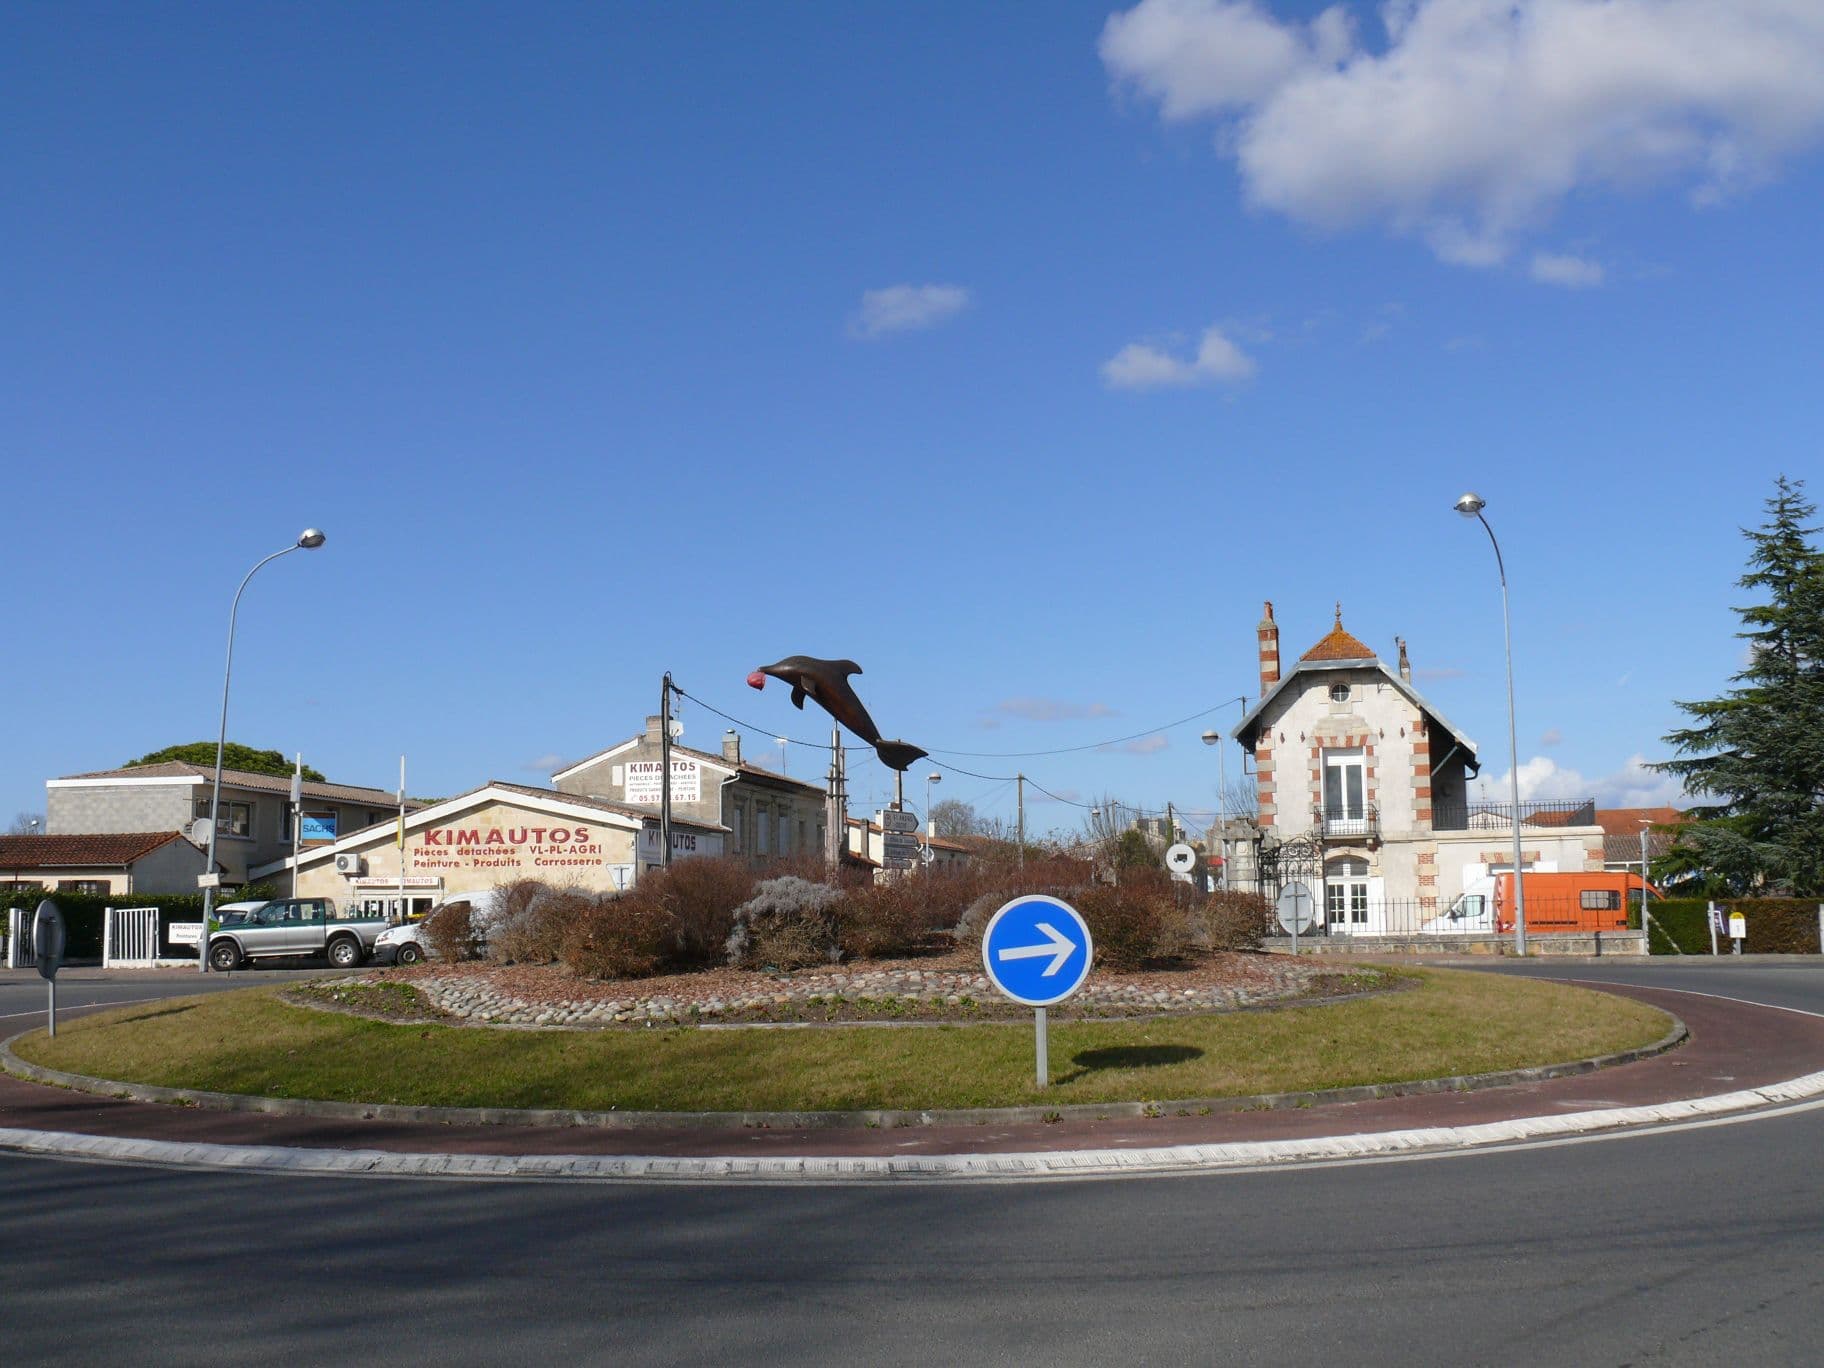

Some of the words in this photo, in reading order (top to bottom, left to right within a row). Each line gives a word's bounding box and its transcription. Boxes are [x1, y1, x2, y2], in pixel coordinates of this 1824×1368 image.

[630, 762, 696, 773] KIMATOS
[303, 824, 335, 833] SACHS
[424, 827, 590, 846] KIMAUTOS
[648, 829, 696, 851] KIUTOS
[529, 844, 602, 855] VL-PL-AGRI
[413, 859, 460, 868] Peinture
[473, 857, 522, 868] Produits
[534, 857, 602, 866] Carrosserie
